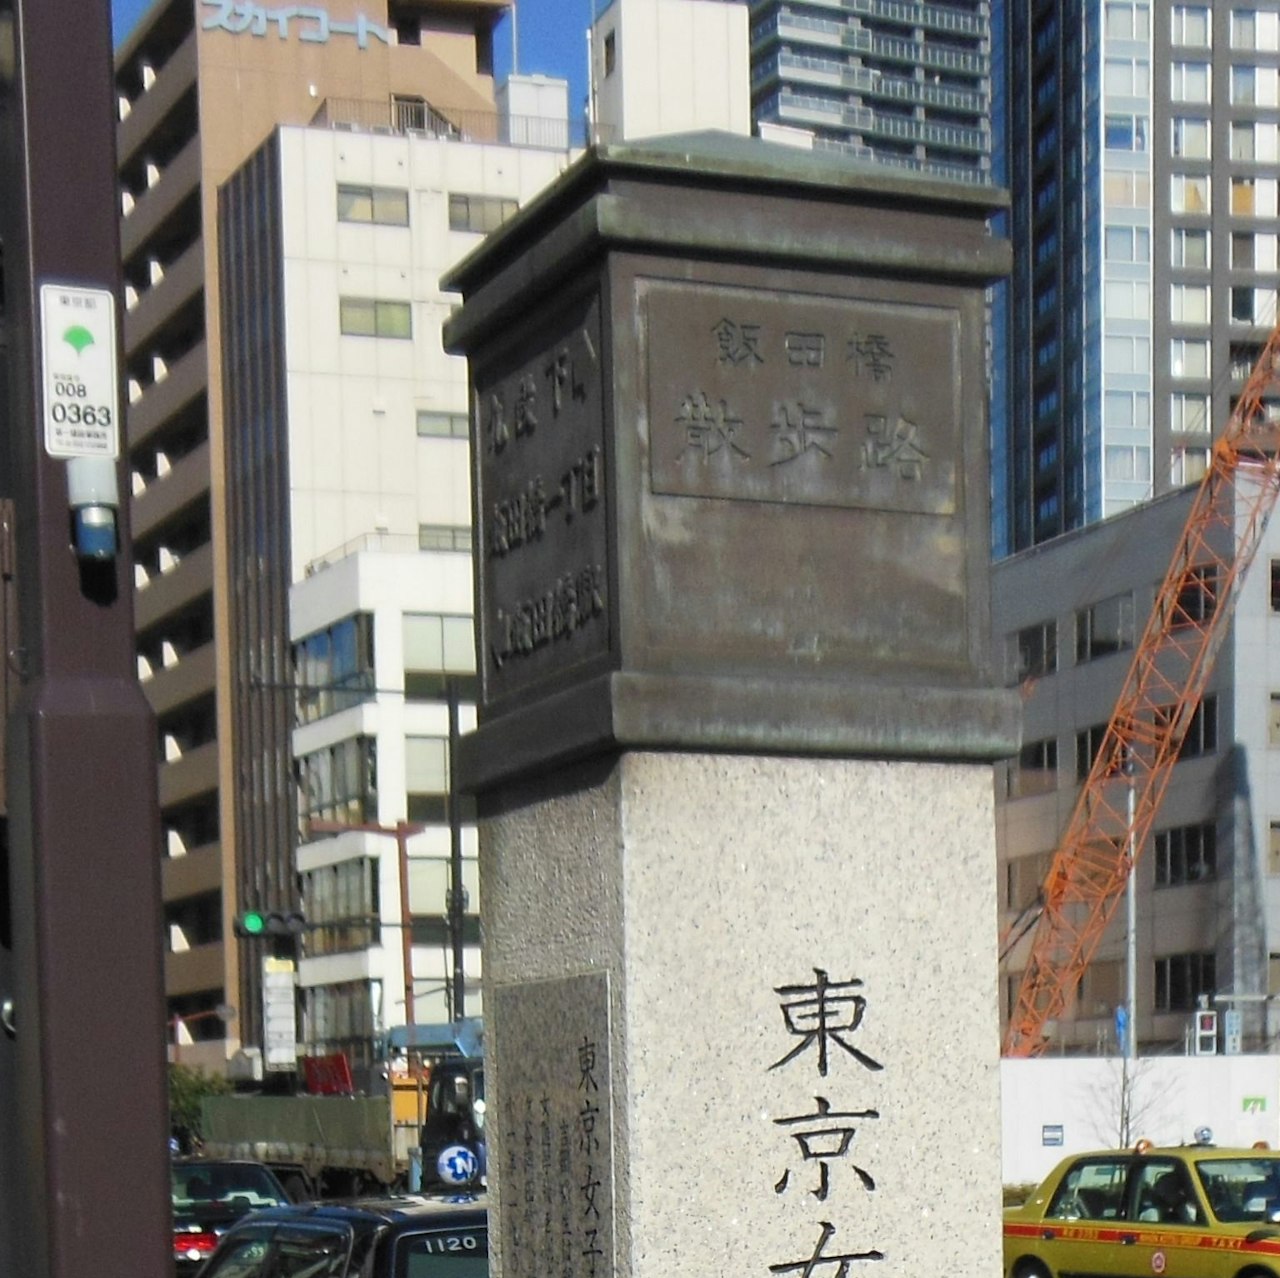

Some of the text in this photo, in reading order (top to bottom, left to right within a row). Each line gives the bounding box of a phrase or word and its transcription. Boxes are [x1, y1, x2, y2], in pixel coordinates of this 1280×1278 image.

[202, 0, 388, 50] スカイコート
[710, 316, 895, 382] 飯田橋
[55, 382, 87, 398] 008
[52, 402, 111, 427] 0363
[674, 390, 931, 481] 散歩路
[454, 1156, 473, 1176] N
[425, 1236, 477, 1254] 1120
[1211, 1238, 1243, 1249] TAXI
